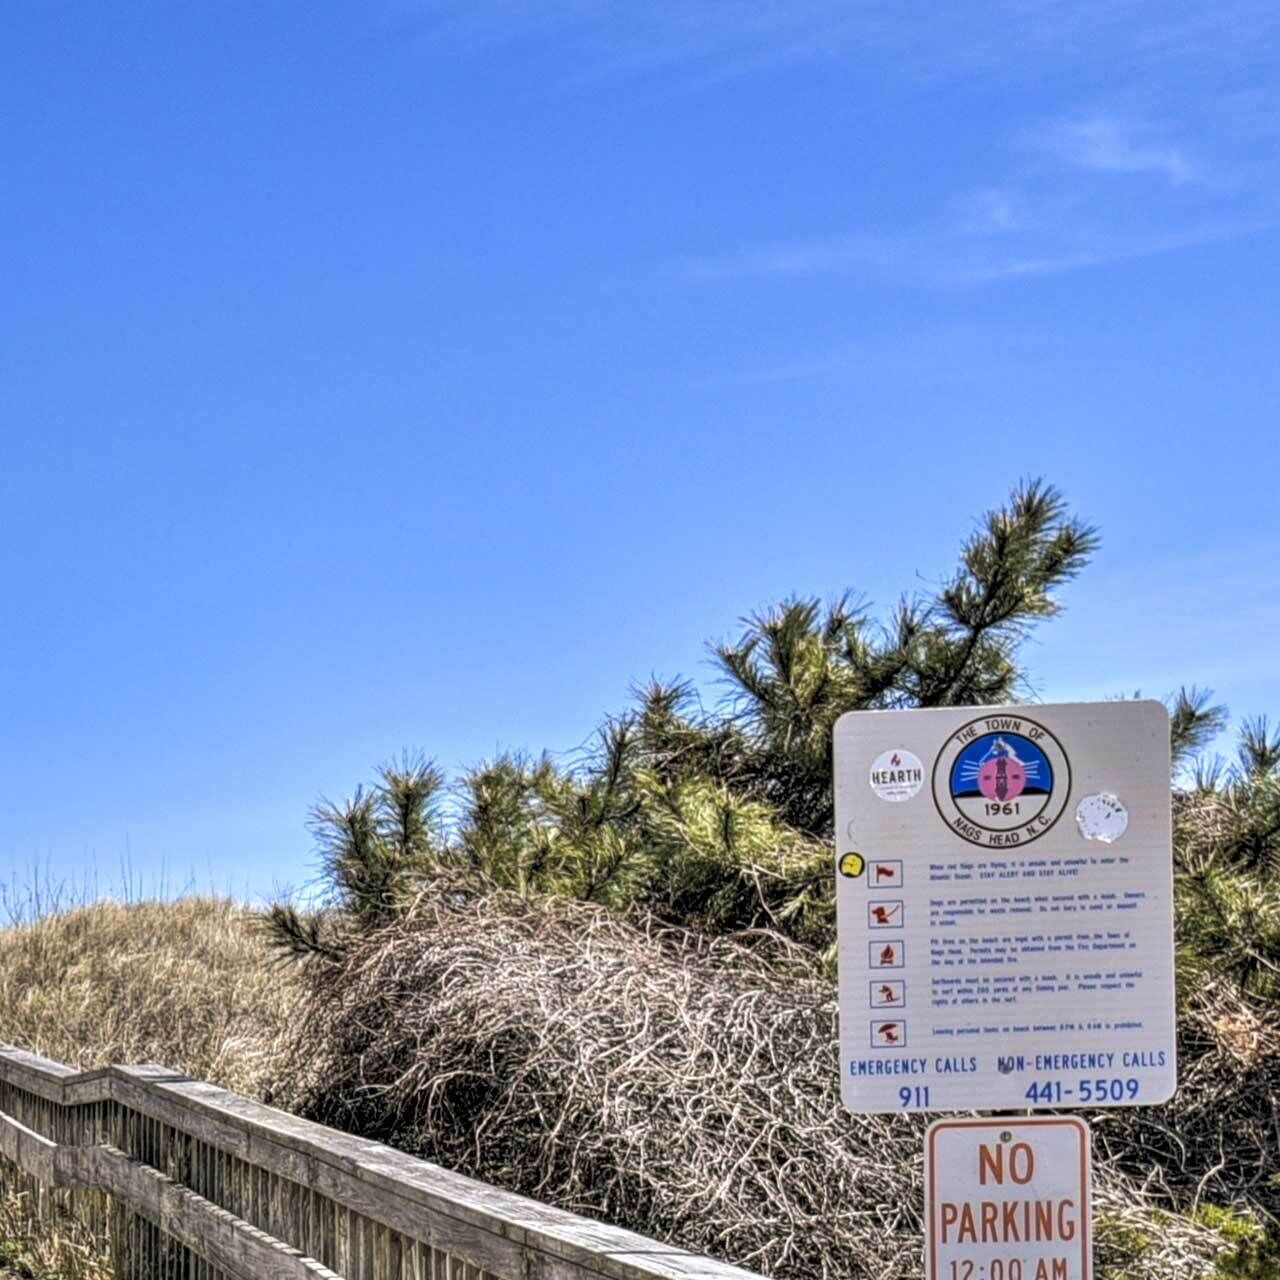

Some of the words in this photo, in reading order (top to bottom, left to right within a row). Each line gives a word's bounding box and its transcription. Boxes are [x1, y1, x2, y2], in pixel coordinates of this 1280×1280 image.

[955, 726, 978, 745] THE
[985, 719, 1022, 731] TOWN
[1028, 727, 1045, 741] OF
[871, 769, 922, 785] HEARTH
[984, 802, 1021, 816] 1961
[953, 817, 982, 841] NAGS
[988, 832, 1020, 846] HEAD
[850, 1058, 927, 1076] EMERGENCY
[935, 1056, 977, 1073] CALLS
[997, 1052, 1115, 1072] NON-EMERGENCY
[1123, 1051, 1166, 1068] CALLS
[899, 1085, 930, 1107] 911
[1024, 1078, 1140, 1103] 441-5509
[978, 1142, 1034, 1186] NO
[940, 1199, 1076, 1245] PARKING
